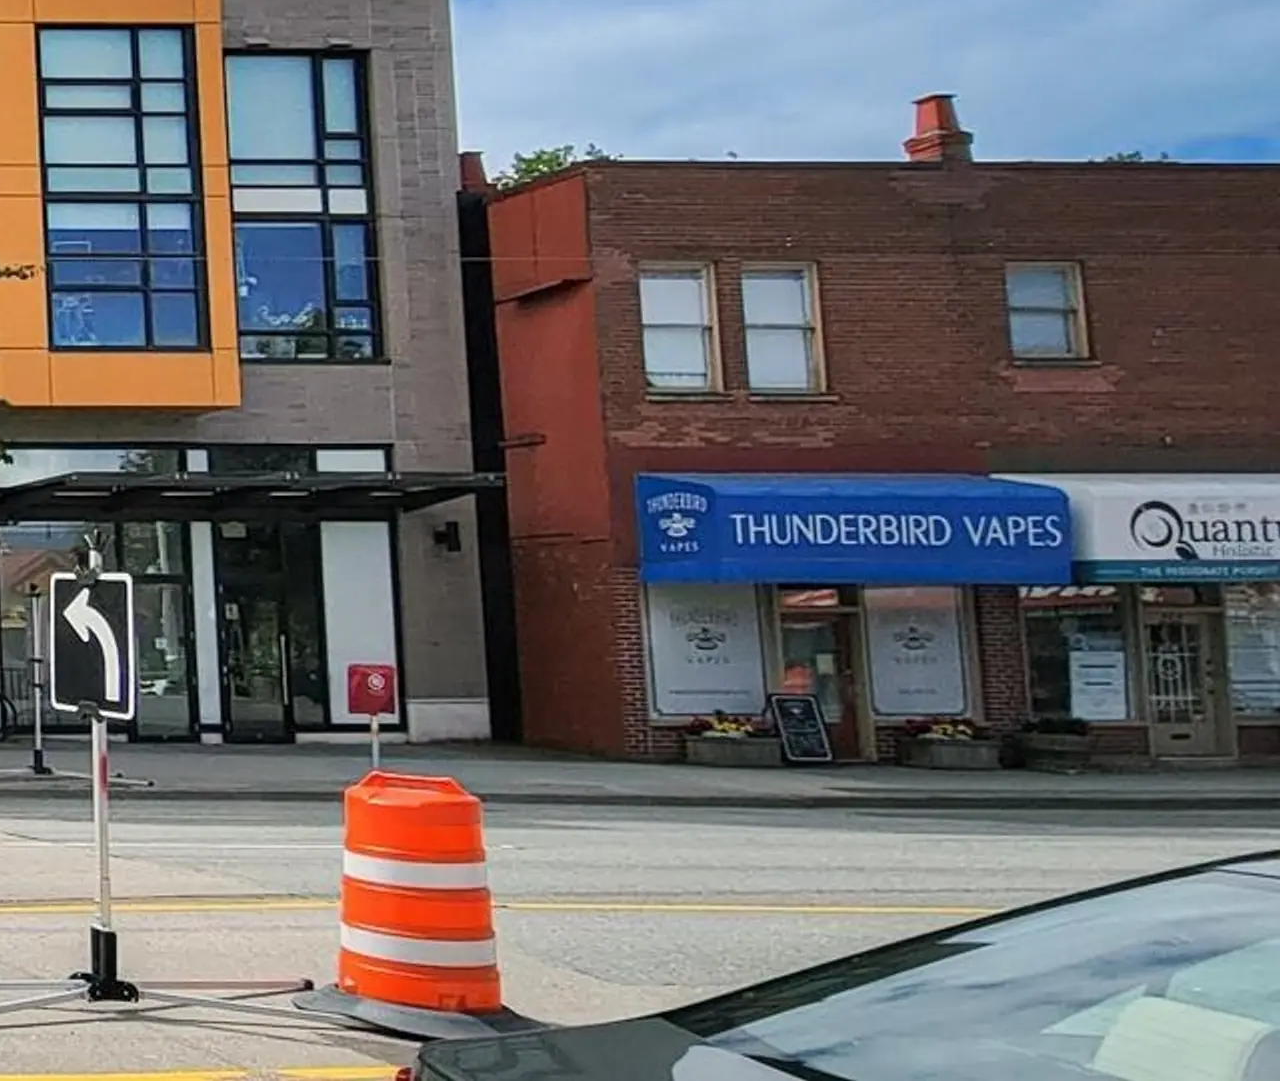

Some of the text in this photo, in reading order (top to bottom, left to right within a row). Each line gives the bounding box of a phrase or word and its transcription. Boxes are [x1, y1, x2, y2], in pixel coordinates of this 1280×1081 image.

[731, 514, 1063, 547] THUNDERBIRD VAPES
[660, 540, 700, 553] VAPES
